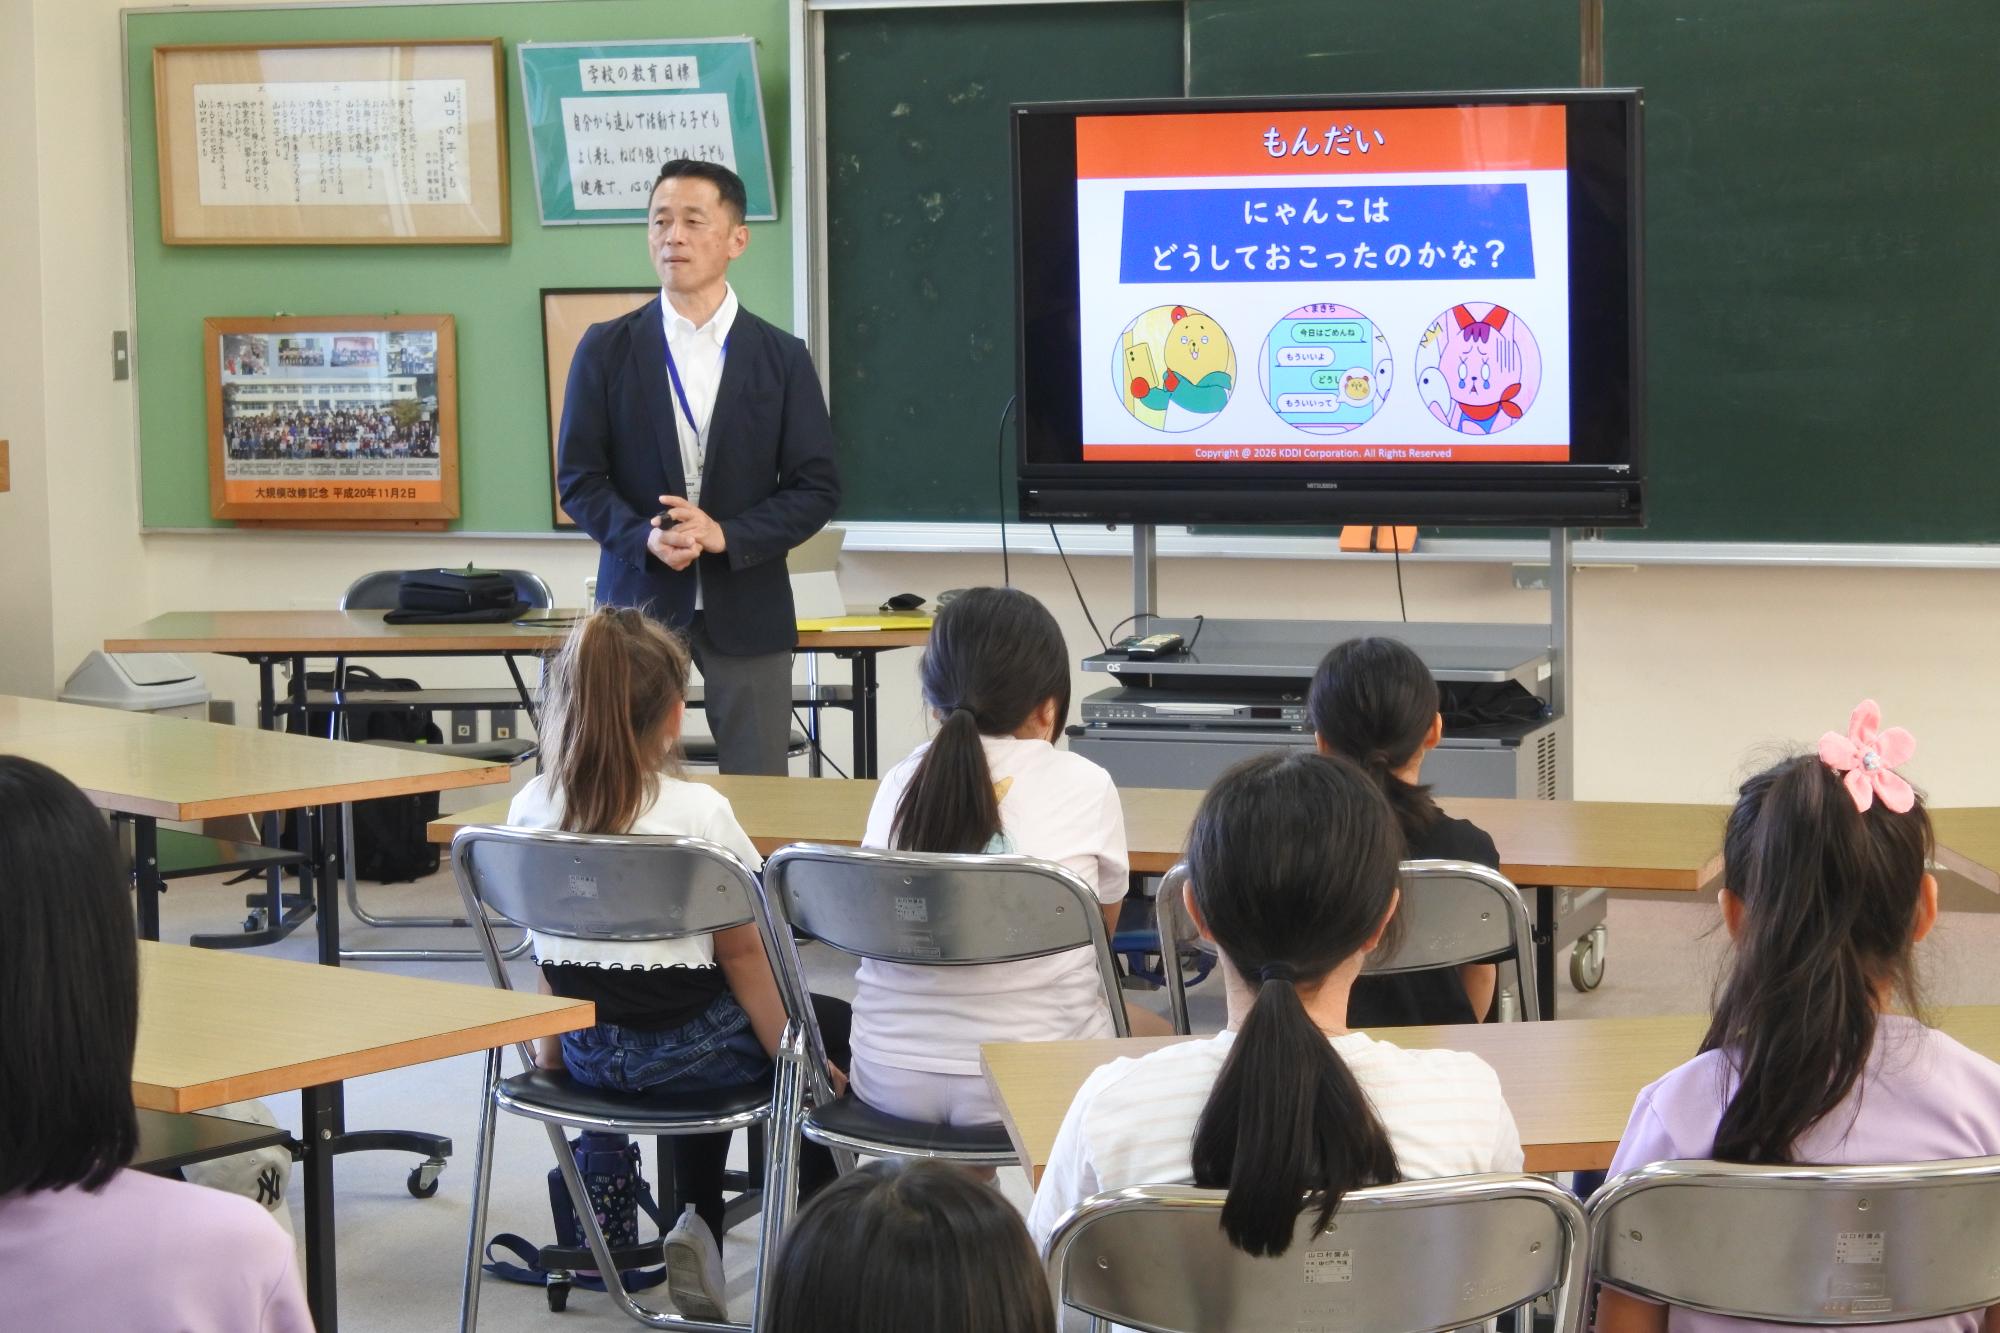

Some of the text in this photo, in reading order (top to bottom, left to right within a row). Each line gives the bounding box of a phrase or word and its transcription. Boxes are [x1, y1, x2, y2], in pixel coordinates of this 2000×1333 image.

[587, 63, 691, 84] 学校の教育目標
[199, 99, 209, 157] 山口の子ども
[272, 102, 281, 158] 山口の子ども
[572, 110, 720, 132] 自分から進んで活動する子ども
[443, 92, 457, 189] 山口の子ども
[1263, 125, 1385, 158] もんだい
[1243, 197, 1391, 225] にゃんこは
[1152, 238, 1506, 273] どうしておこったのかな？
[1300, 328, 1355, 338] 今日はごめんね
[1286, 353, 1325, 361] もういいよ
[1285, 399, 1333, 408] もういいって
[1195, 448, 1452, 459] Copyright @ 2026 KDDI Corporation. All Rights Reserved
[255, 487, 417, 499] 大規模改修記念 平成20年11月2日
[256, 1167, 281, 1205] NY
